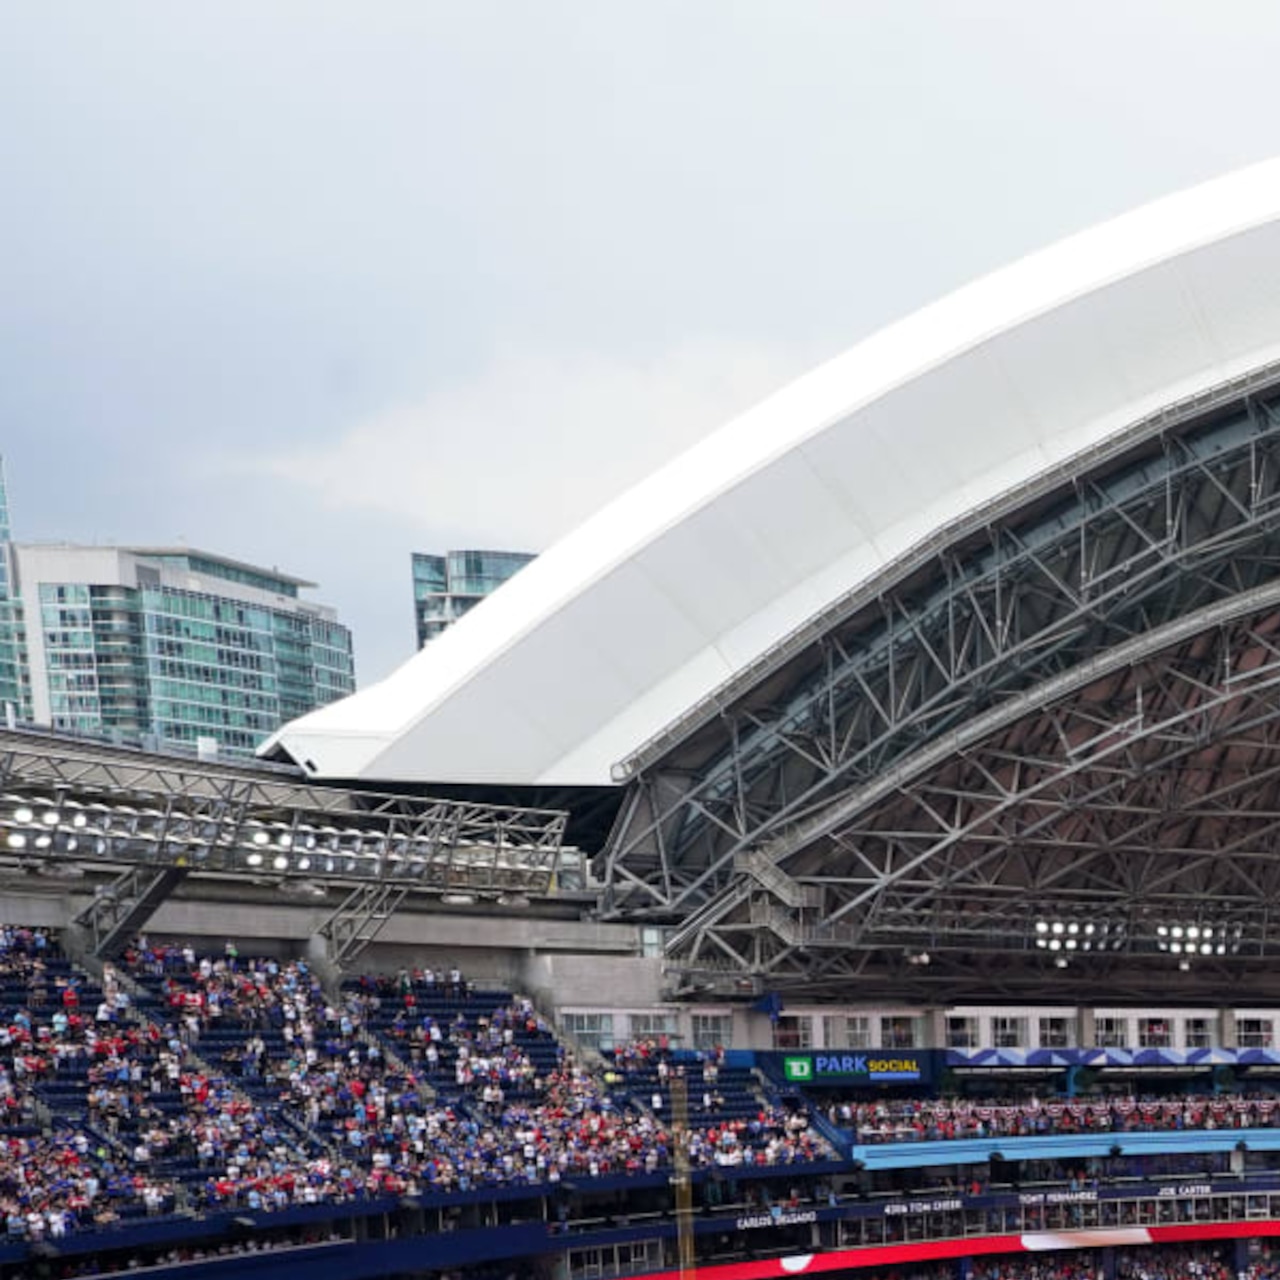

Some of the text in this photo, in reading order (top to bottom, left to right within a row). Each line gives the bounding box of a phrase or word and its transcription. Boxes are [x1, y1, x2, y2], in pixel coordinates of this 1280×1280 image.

[790, 1055, 920, 1077] TD PARK SOCIAL
